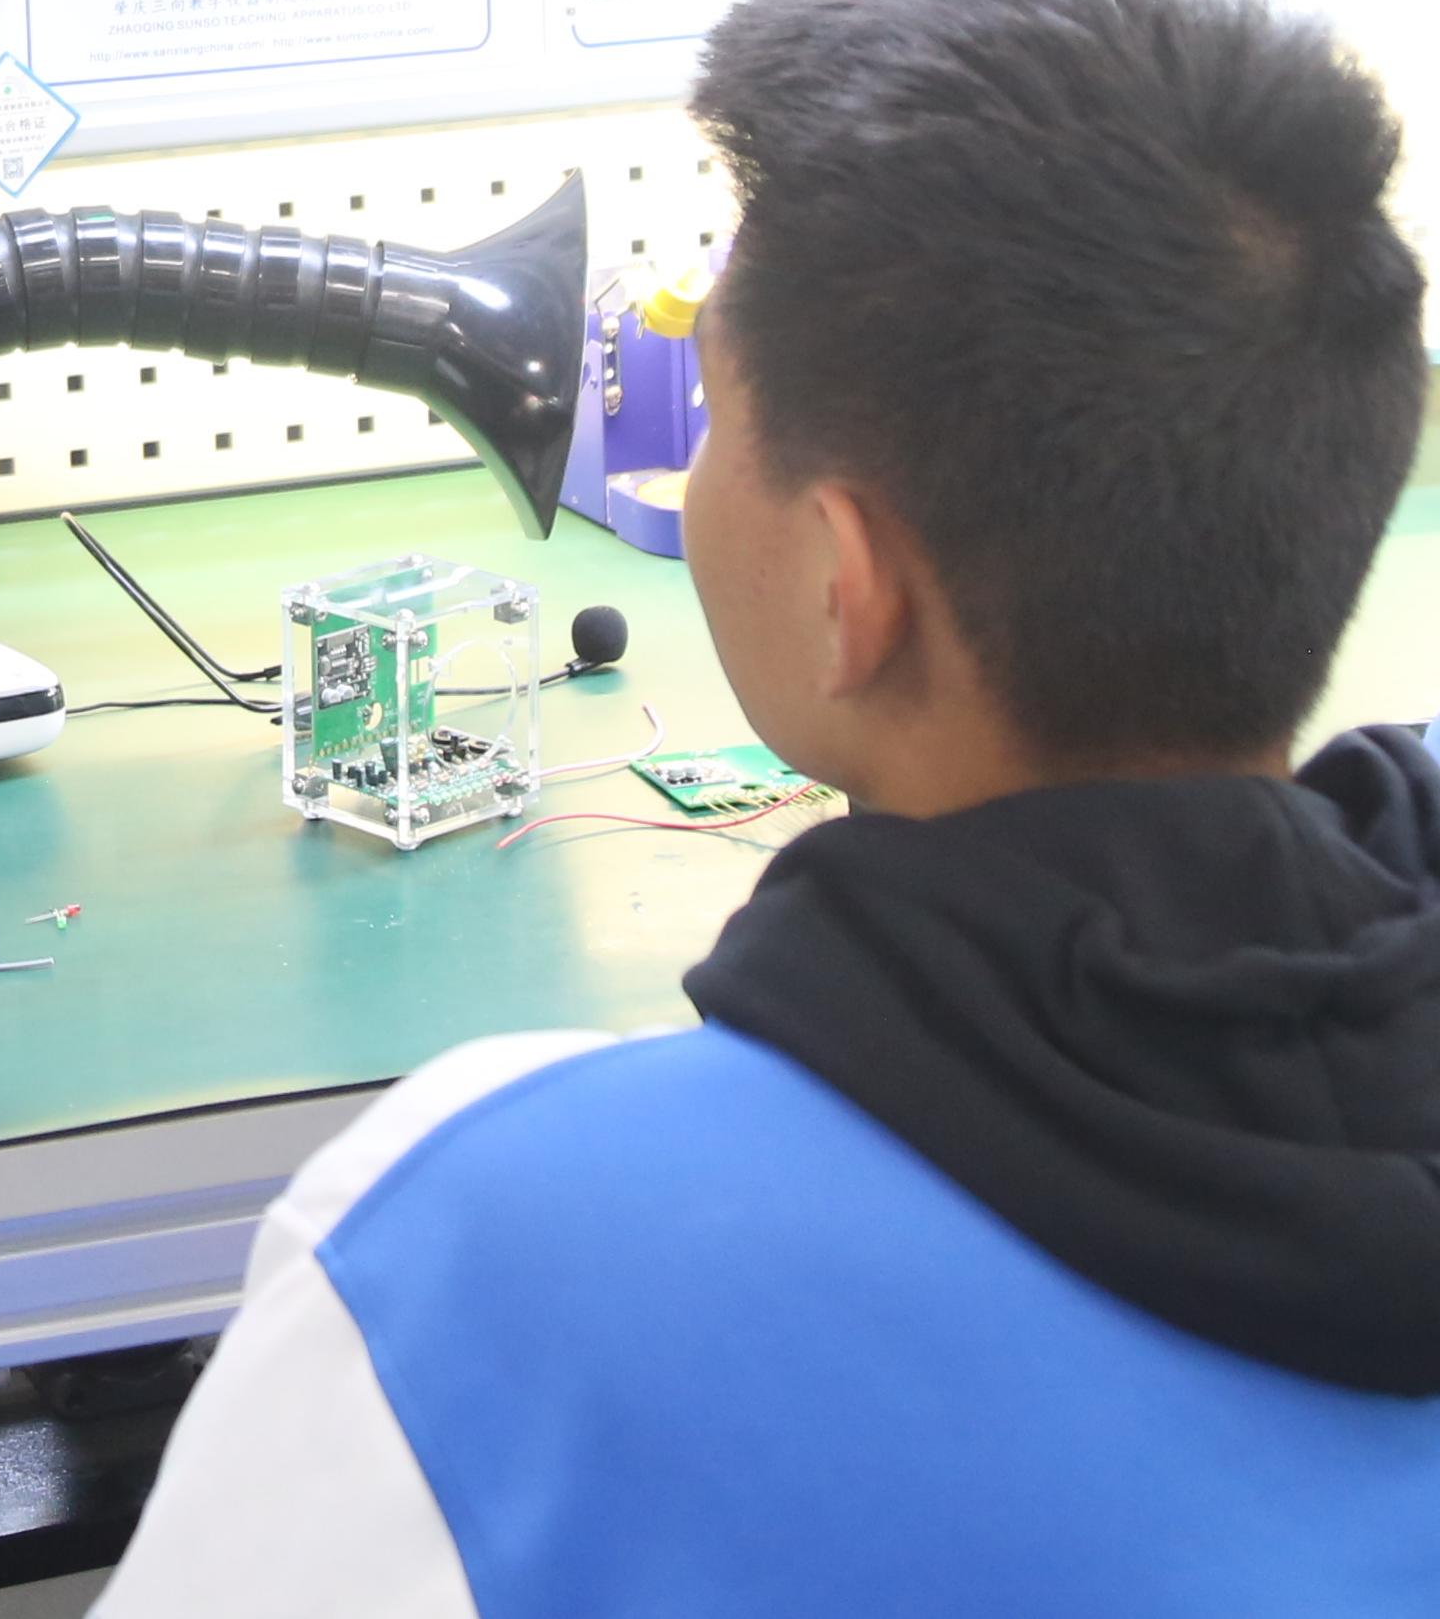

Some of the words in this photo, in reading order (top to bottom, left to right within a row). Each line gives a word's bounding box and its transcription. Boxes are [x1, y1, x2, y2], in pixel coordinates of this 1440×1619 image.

[108, 19, 176, 36] ZHAOQING
[176, 15, 222, 31] SUNSO
[223, 11, 287, 27] TEACHING
[291, 4, 365, 21] APPARATUS
